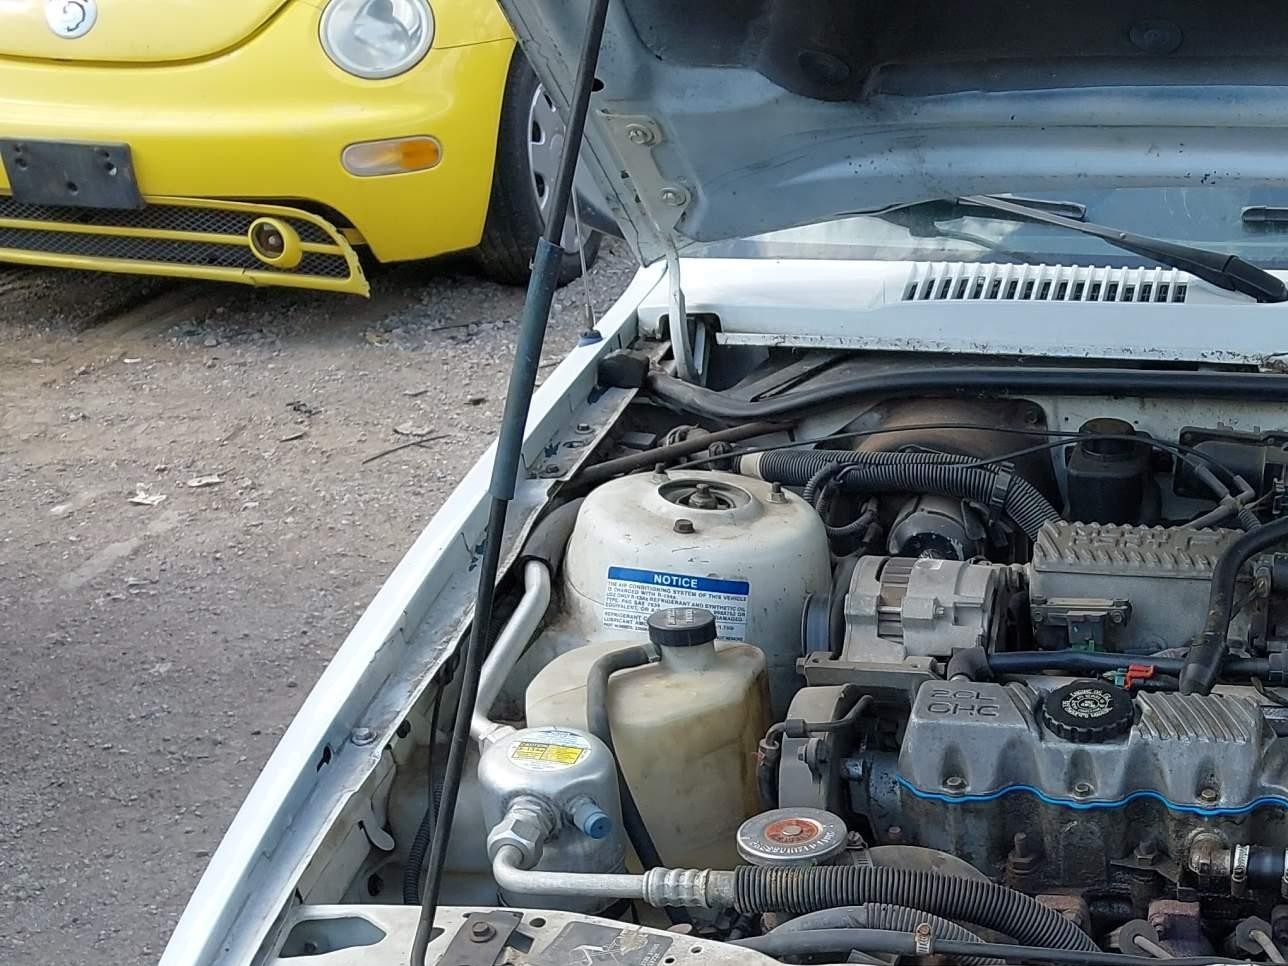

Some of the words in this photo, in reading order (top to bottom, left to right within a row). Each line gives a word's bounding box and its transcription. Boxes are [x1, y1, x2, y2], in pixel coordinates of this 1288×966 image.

[653, 573, 698, 588] NOTICE
[628, 584, 671, 593] CONDITIONING
[927, 701, 1000, 717] OHC
